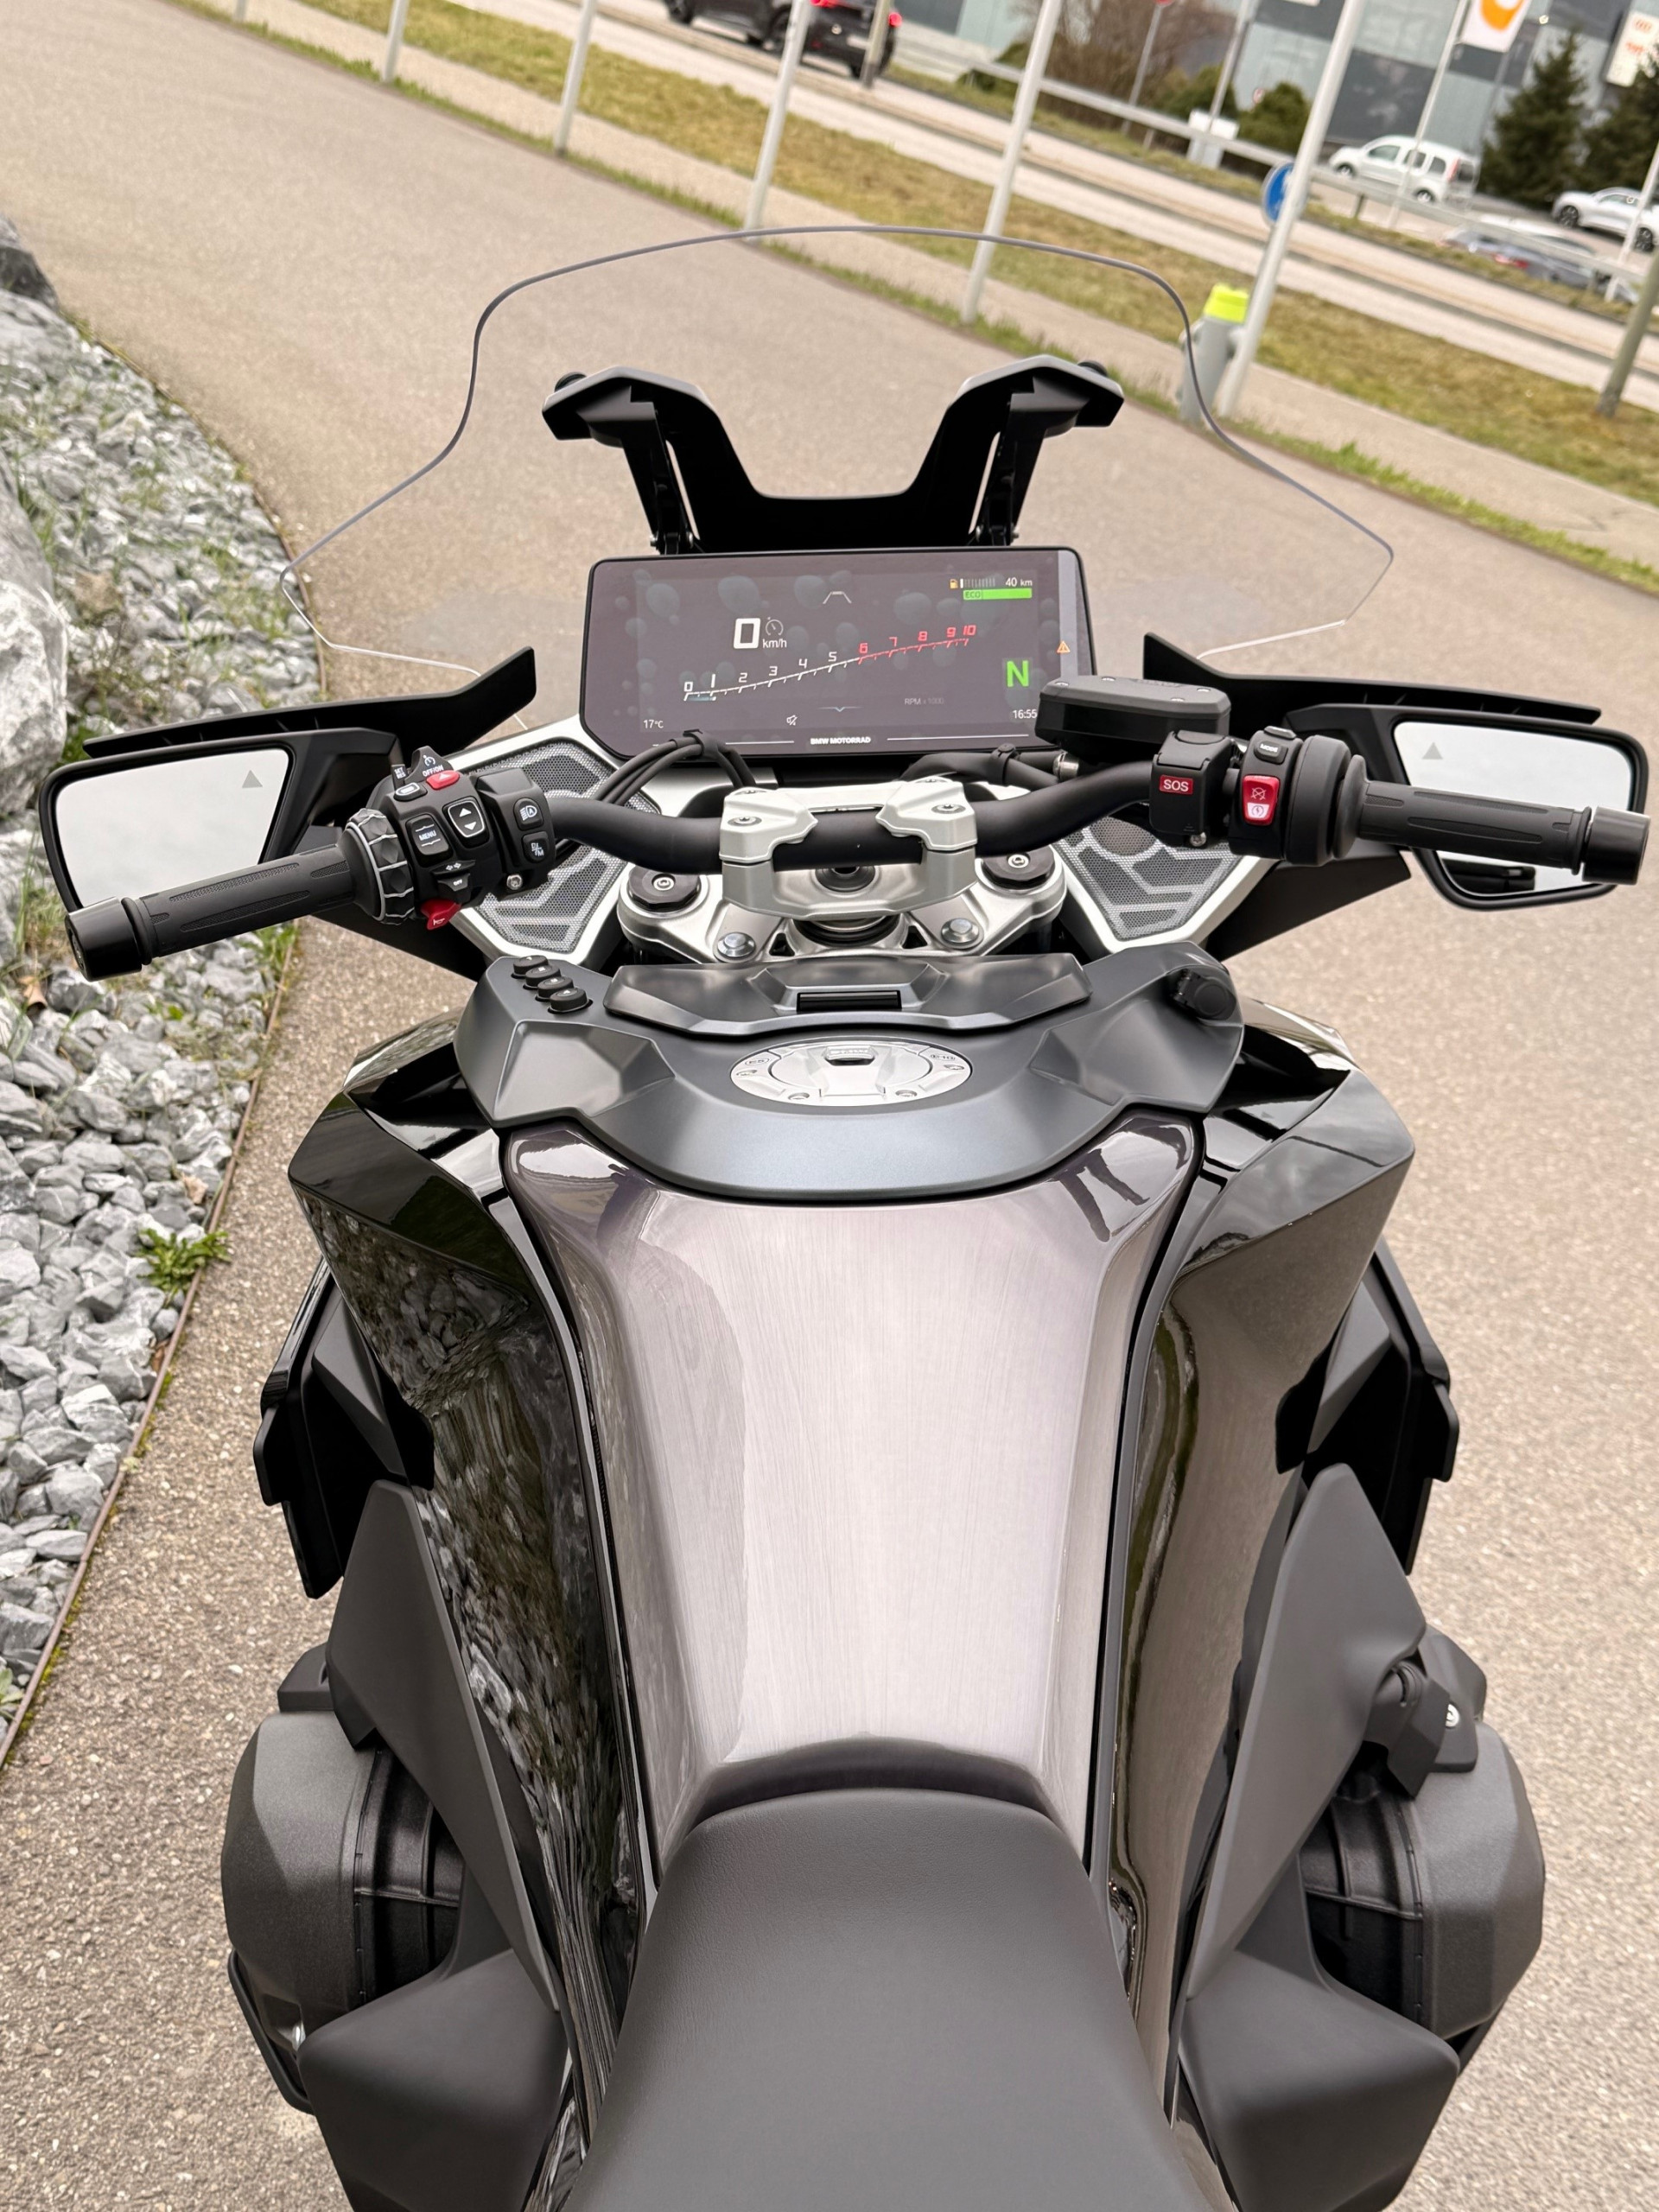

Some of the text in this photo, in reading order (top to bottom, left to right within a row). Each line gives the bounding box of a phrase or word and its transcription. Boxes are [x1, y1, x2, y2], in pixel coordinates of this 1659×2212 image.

[1005, 576, 1033, 587] 40 km
[734, 618, 760, 649] 0
[762, 639, 787, 648] km/h
[683, 625, 976, 692] 0 1 2 3 4 5 6 7 8 9 10
[1006, 660, 1029, 688] N
[1013, 709, 1037, 719] 16:55
[643, 719, 664, 729] 17°C
[830, 736, 872, 745] MOTORRAD
[1259, 743, 1279, 753] MODE
[422, 765, 444, 778] OFF/ON
[1163, 779, 1189, 792] SOS
[418, 830, 437, 841] MENU
